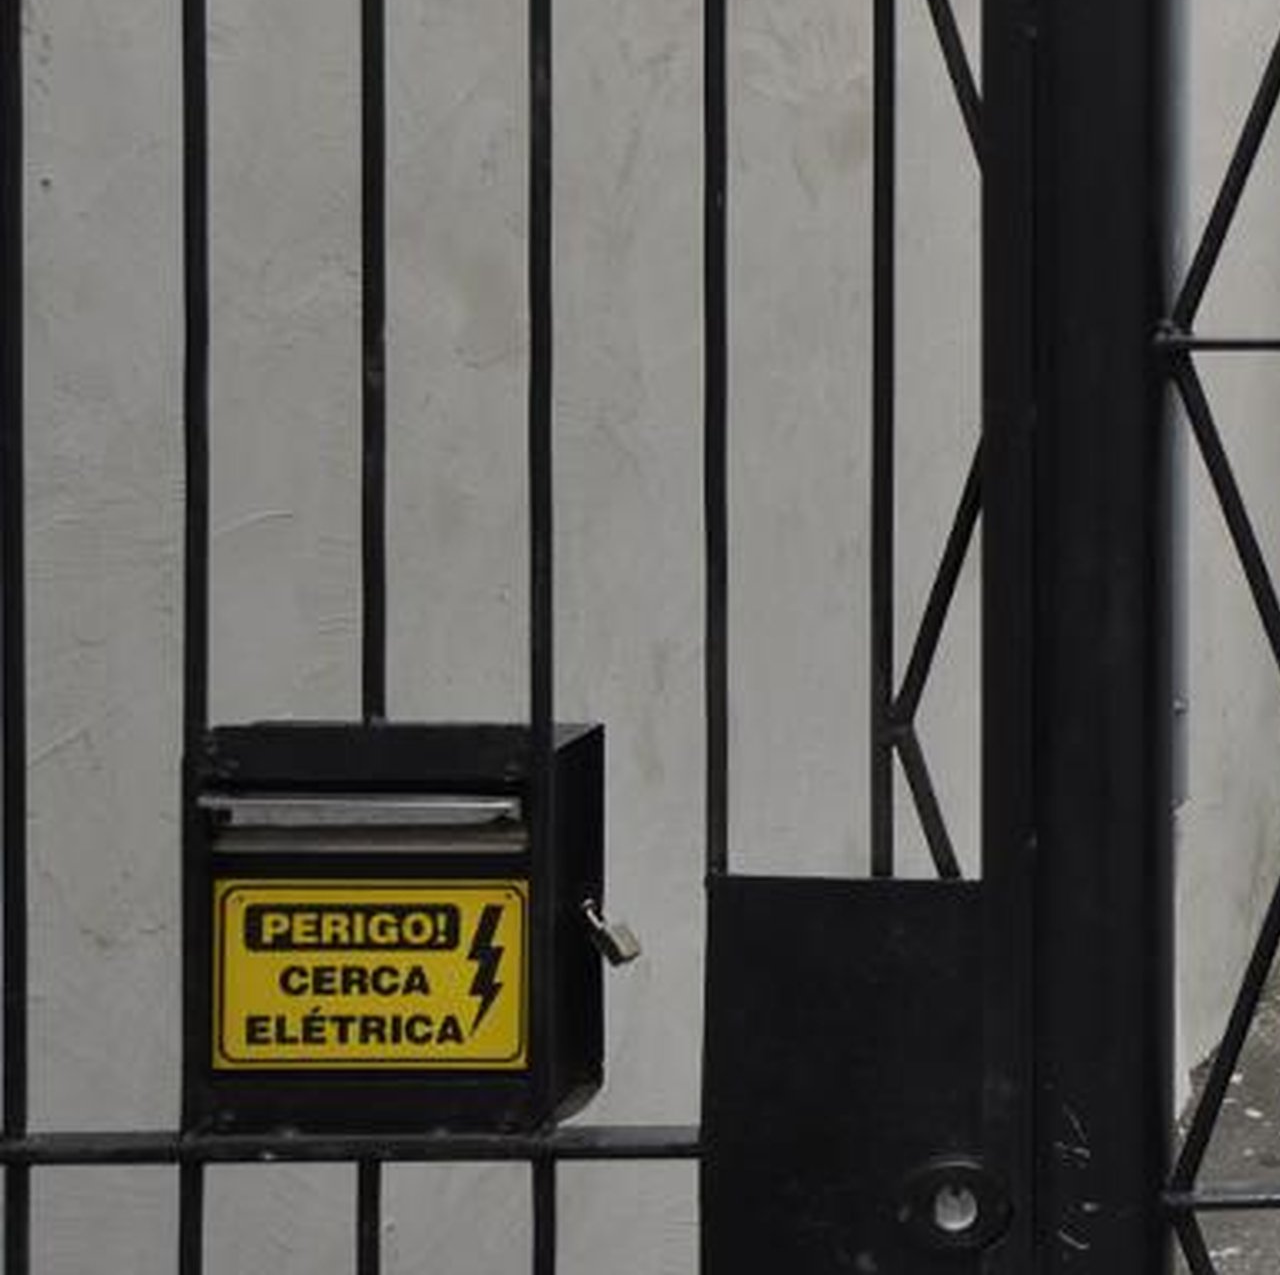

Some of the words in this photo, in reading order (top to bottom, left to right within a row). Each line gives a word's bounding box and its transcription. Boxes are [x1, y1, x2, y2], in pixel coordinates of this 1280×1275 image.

[261, 911, 448, 944] PERIGO!
[278, 965, 430, 998] CERCA
[244, 1007, 465, 1046] ELÉTRICA
